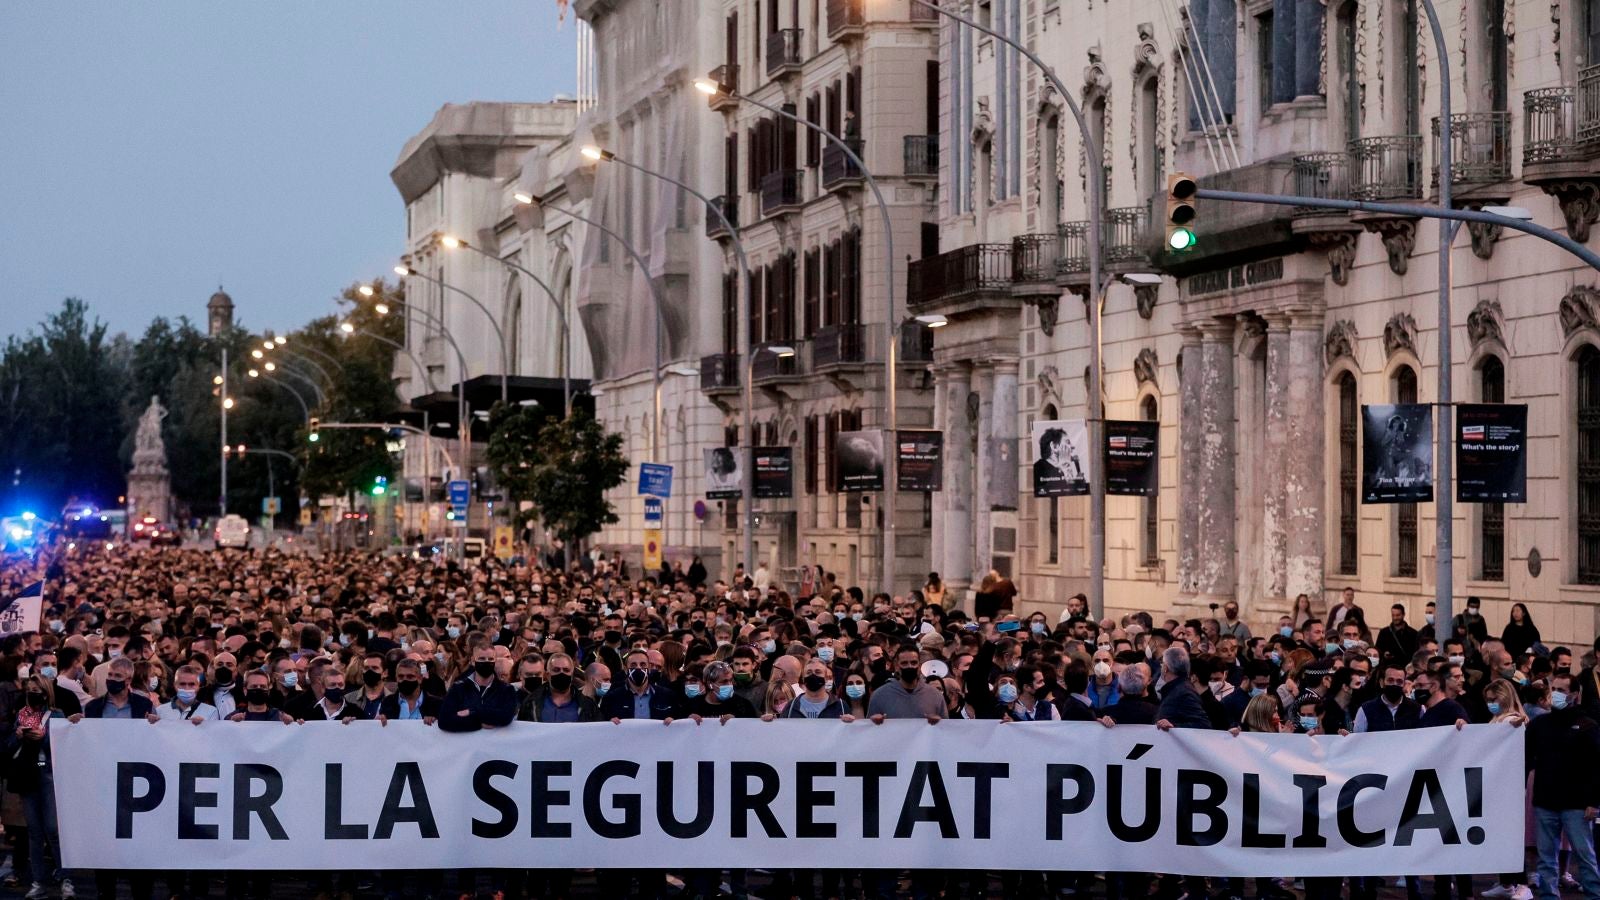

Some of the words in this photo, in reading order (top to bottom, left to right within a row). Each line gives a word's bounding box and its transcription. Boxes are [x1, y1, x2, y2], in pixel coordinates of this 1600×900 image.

[1498, 444, 1520, 452] story?
[115, 761, 290, 840] PER
[324, 761, 440, 840] LA
[471, 759, 1009, 840] SEGURETAT
[1046, 743, 1486, 849] PÚBLICA!
